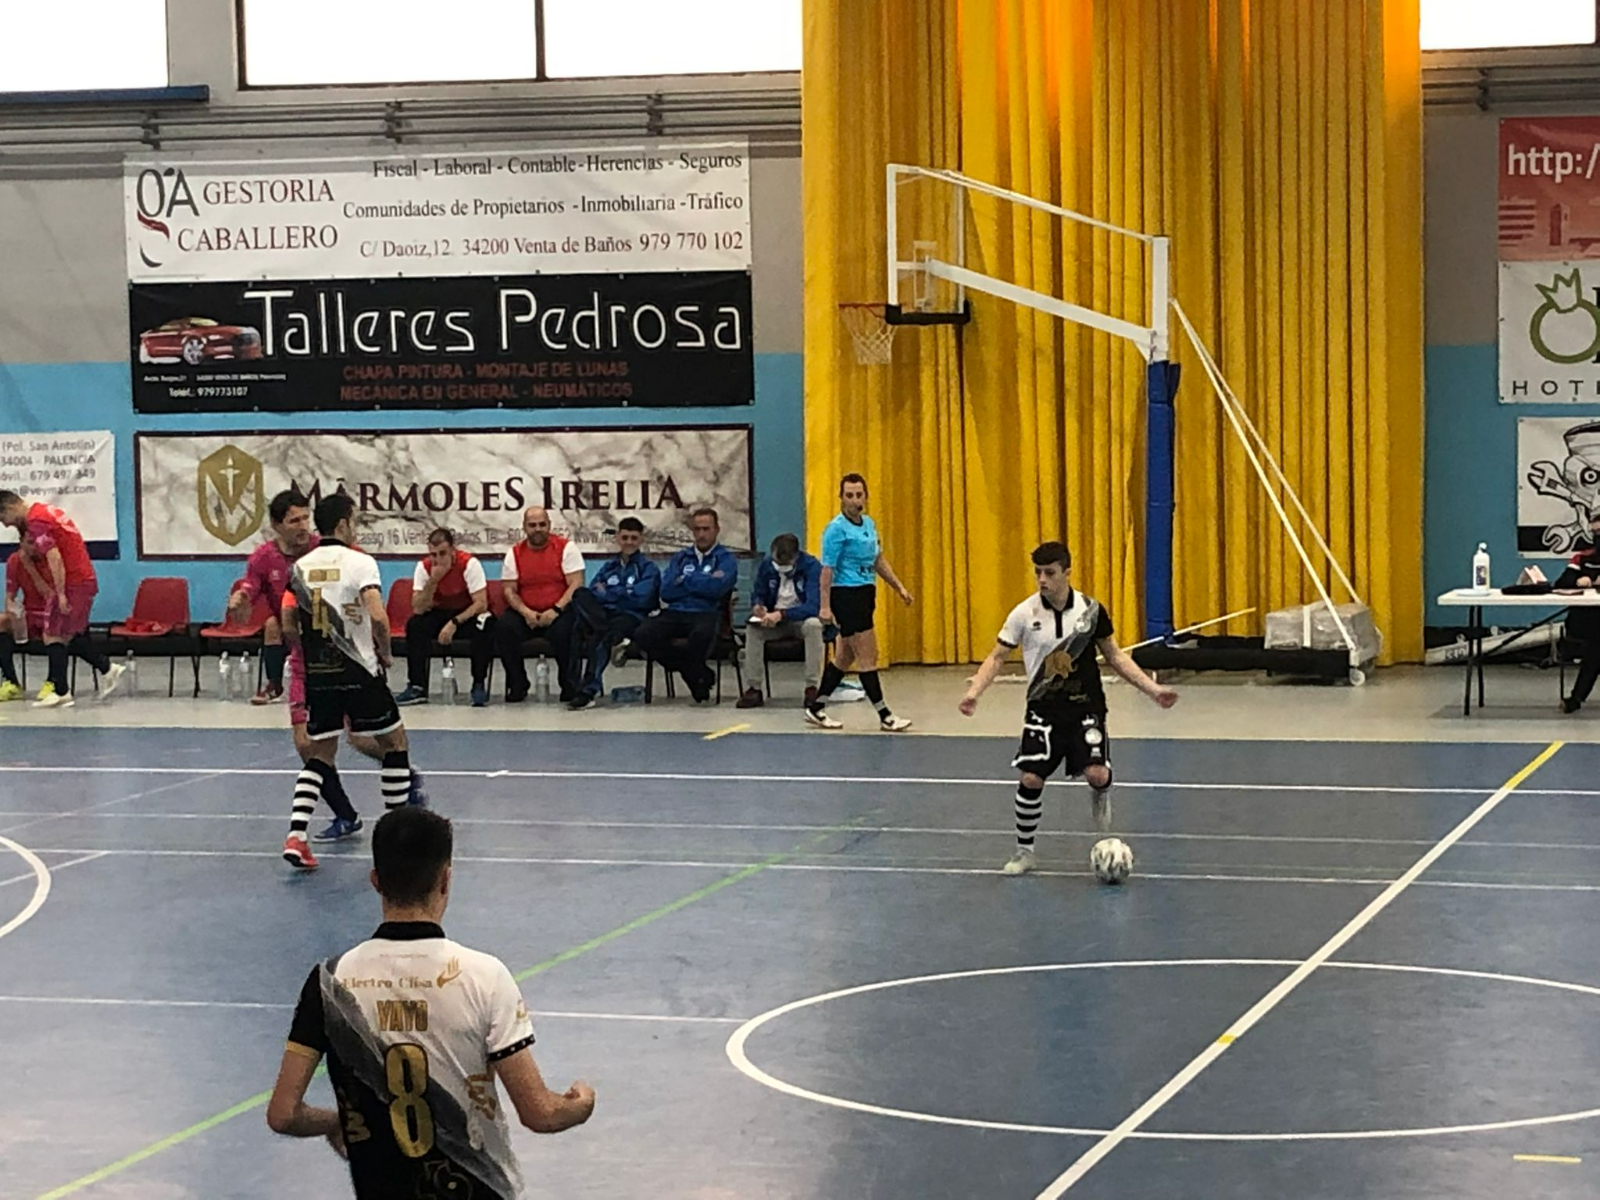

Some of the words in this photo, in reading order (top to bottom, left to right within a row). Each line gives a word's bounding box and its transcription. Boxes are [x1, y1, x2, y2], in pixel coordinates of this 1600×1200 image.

[373, 159, 418, 178] Fiscal
[433, 157, 492, 176] Laboral
[679, 152, 742, 173] Seguros
[203, 179, 335, 205] GESTORIA
[343, 199, 446, 219] Comunidades
[450, 199, 469, 216] de
[473, 195, 565, 217] Propietarios
[177, 224, 338, 252] CABALLERO
[360, 240, 379, 257] C/
[462, 237, 510, 255] 34200
[514, 235, 557, 254] Venta
[561, 234, 580, 253] de
[584, 233, 632, 252] Baños
[639, 232, 672, 251] 979
[676, 232, 708, 250] 770
[712, 230, 743, 249] 102
[243, 290, 475, 356] Talleres
[500, 288, 742, 350] Pedrosa
[343, 365, 395, 380] CHAPA
[398, 364, 464, 380] PINTURA
[476, 362, 549, 378] MONTAJE
[552, 361, 573, 377] DE
[577, 361, 628, 376] LUNAS
[422, 384, 443, 400] EN
[447, 382, 518, 400] GENERAL
[1513, 380, 1600, 395] HOT
[29, 441, 48, 452] San
[44, 455, 96, 466] PALENCIA
[30, 470, 50, 481] 679
[53, 469, 72, 480] 497
[541, 474, 685, 510] IRELIA
[385, 1043, 435, 1158] 8
